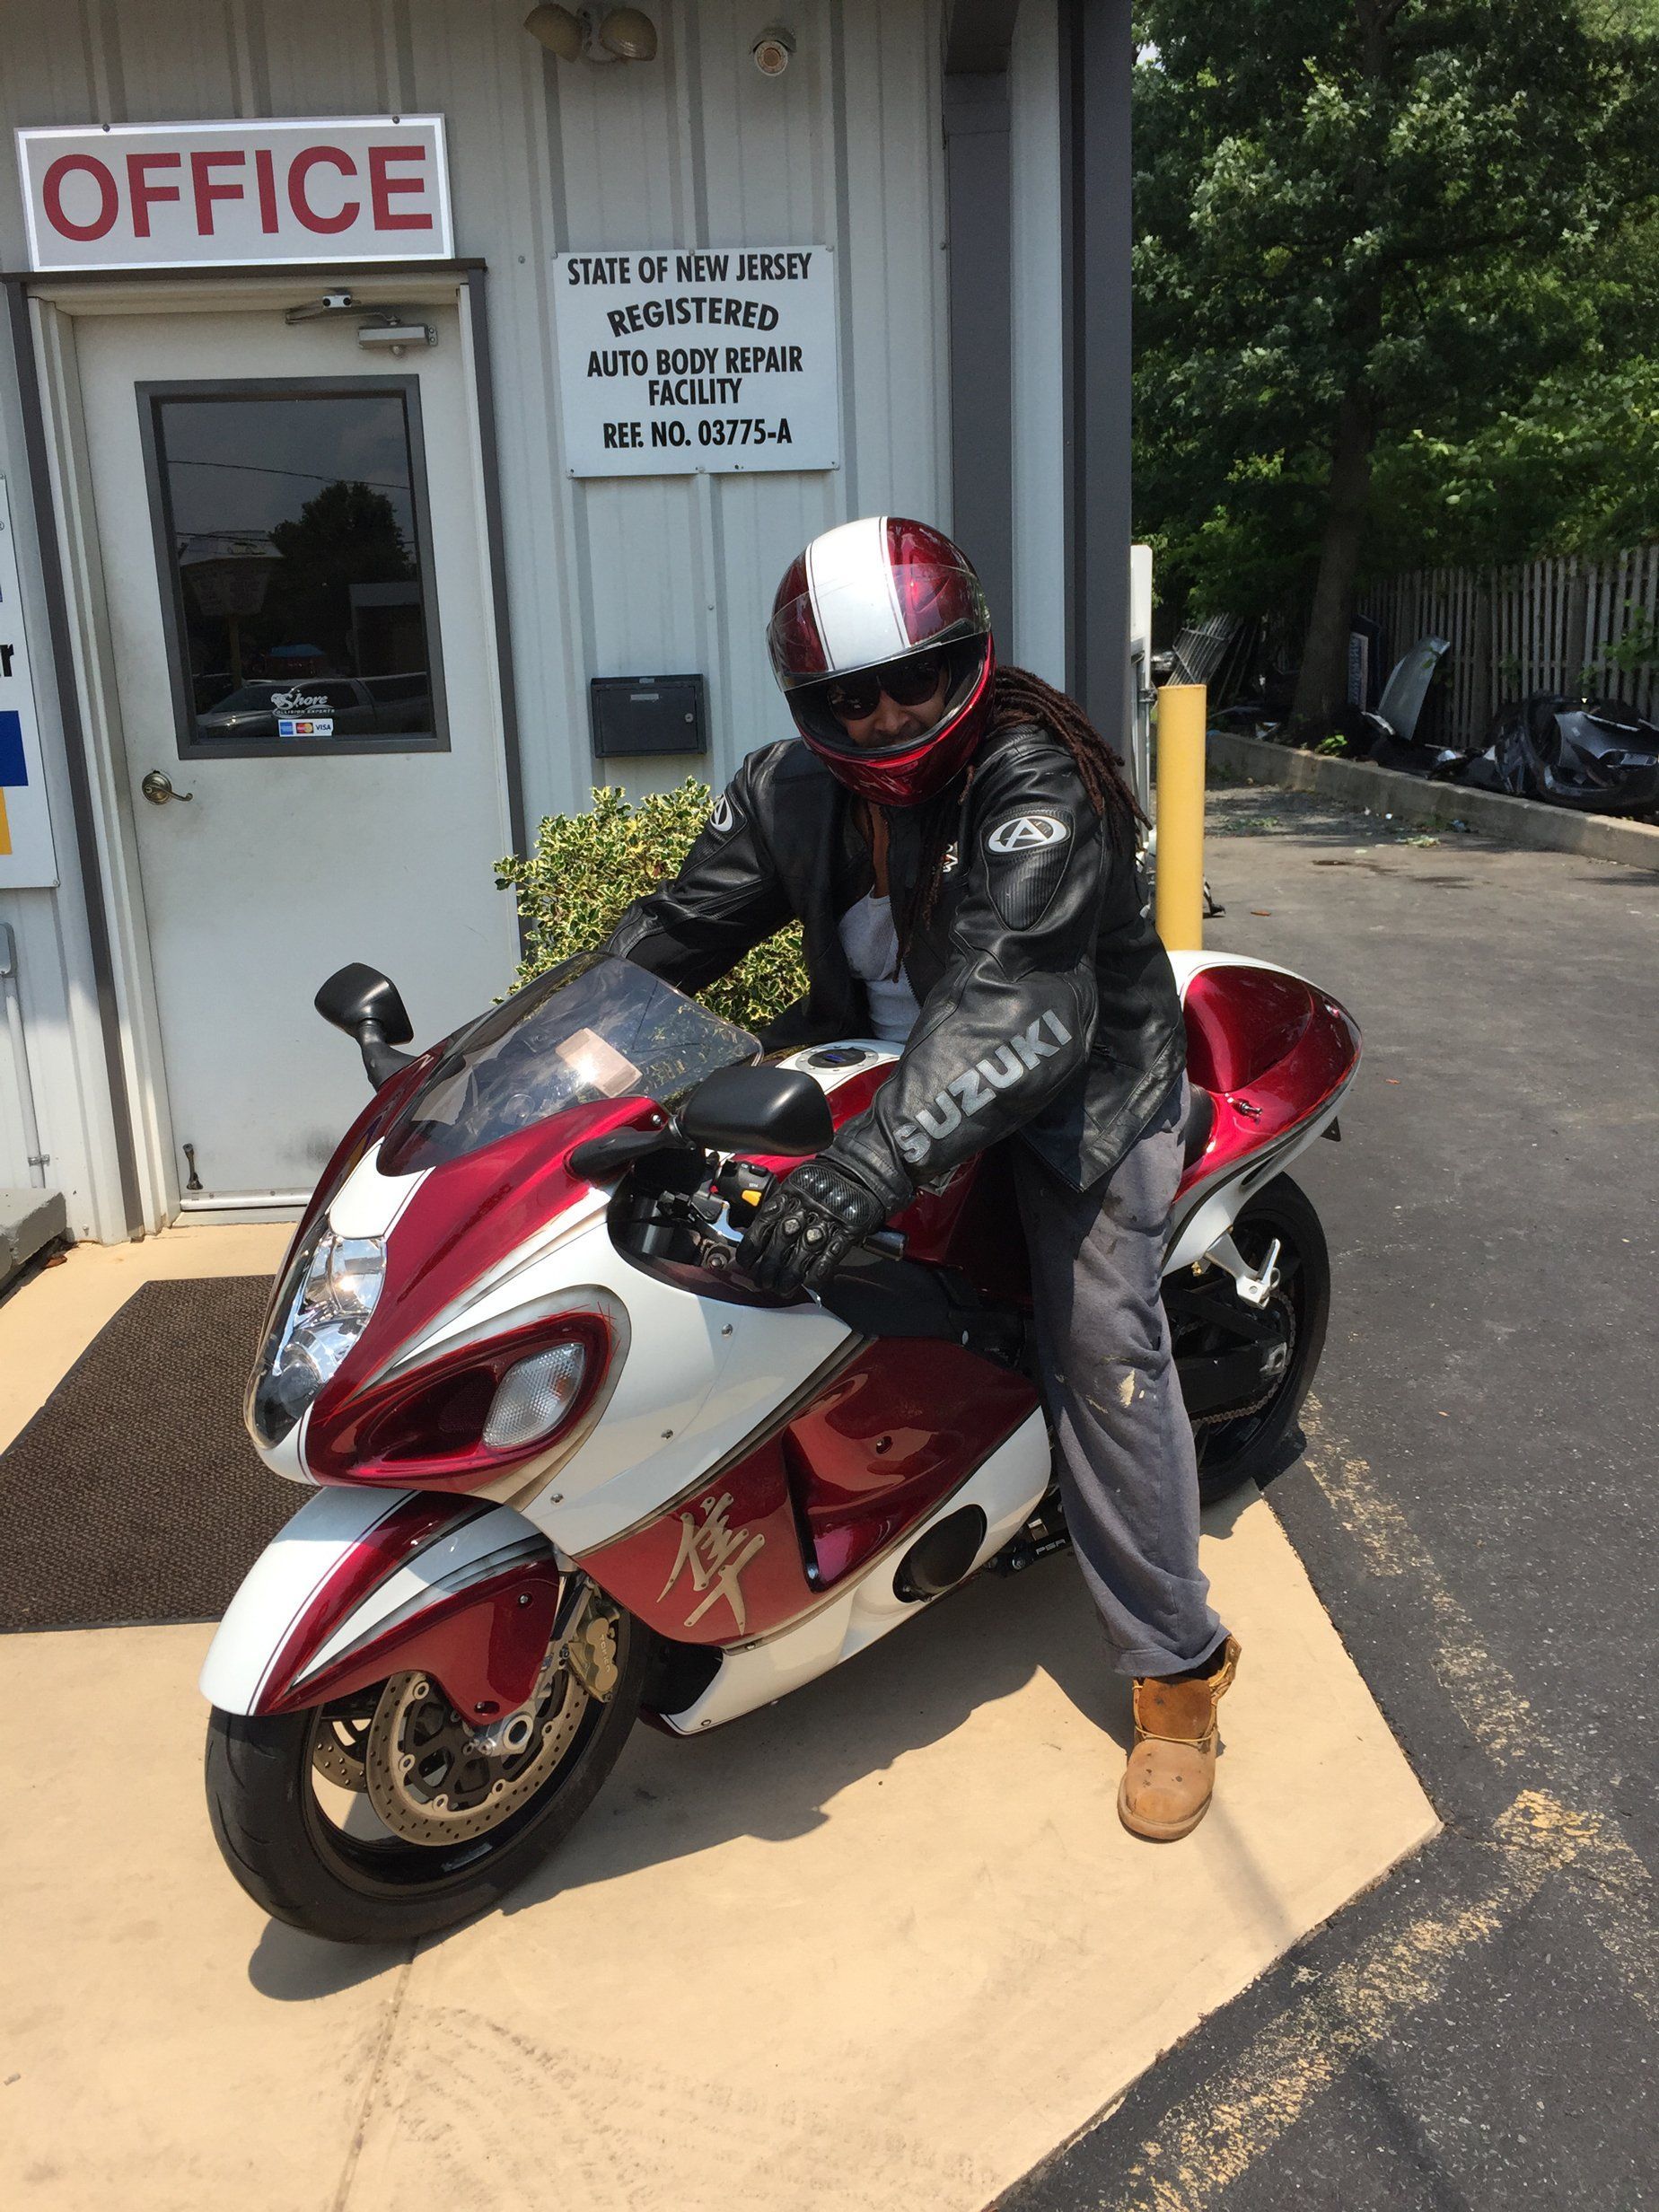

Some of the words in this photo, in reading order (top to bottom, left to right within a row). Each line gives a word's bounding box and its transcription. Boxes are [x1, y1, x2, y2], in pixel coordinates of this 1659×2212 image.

[42, 145, 433, 241] OFFICE
[567, 258, 630, 285] STATE
[638, 256, 668, 283] OF
[676, 255, 729, 283] NEW
[736, 252, 812, 281] JERSEY
[607, 297, 779, 338] REGISTERED
[587, 349, 648, 377] AUTO
[656, 347, 718, 375] BODY
[725, 346, 803, 373] REPAIR
[648, 378, 742, 406] FACILITY
[603, 422, 644, 449] REF.
[651, 420, 691, 447] NO.
[698, 418, 793, 446] 03775-A
[273, 692, 329, 710] Shore
[893, 1009, 1073, 1163] SUZUKI
